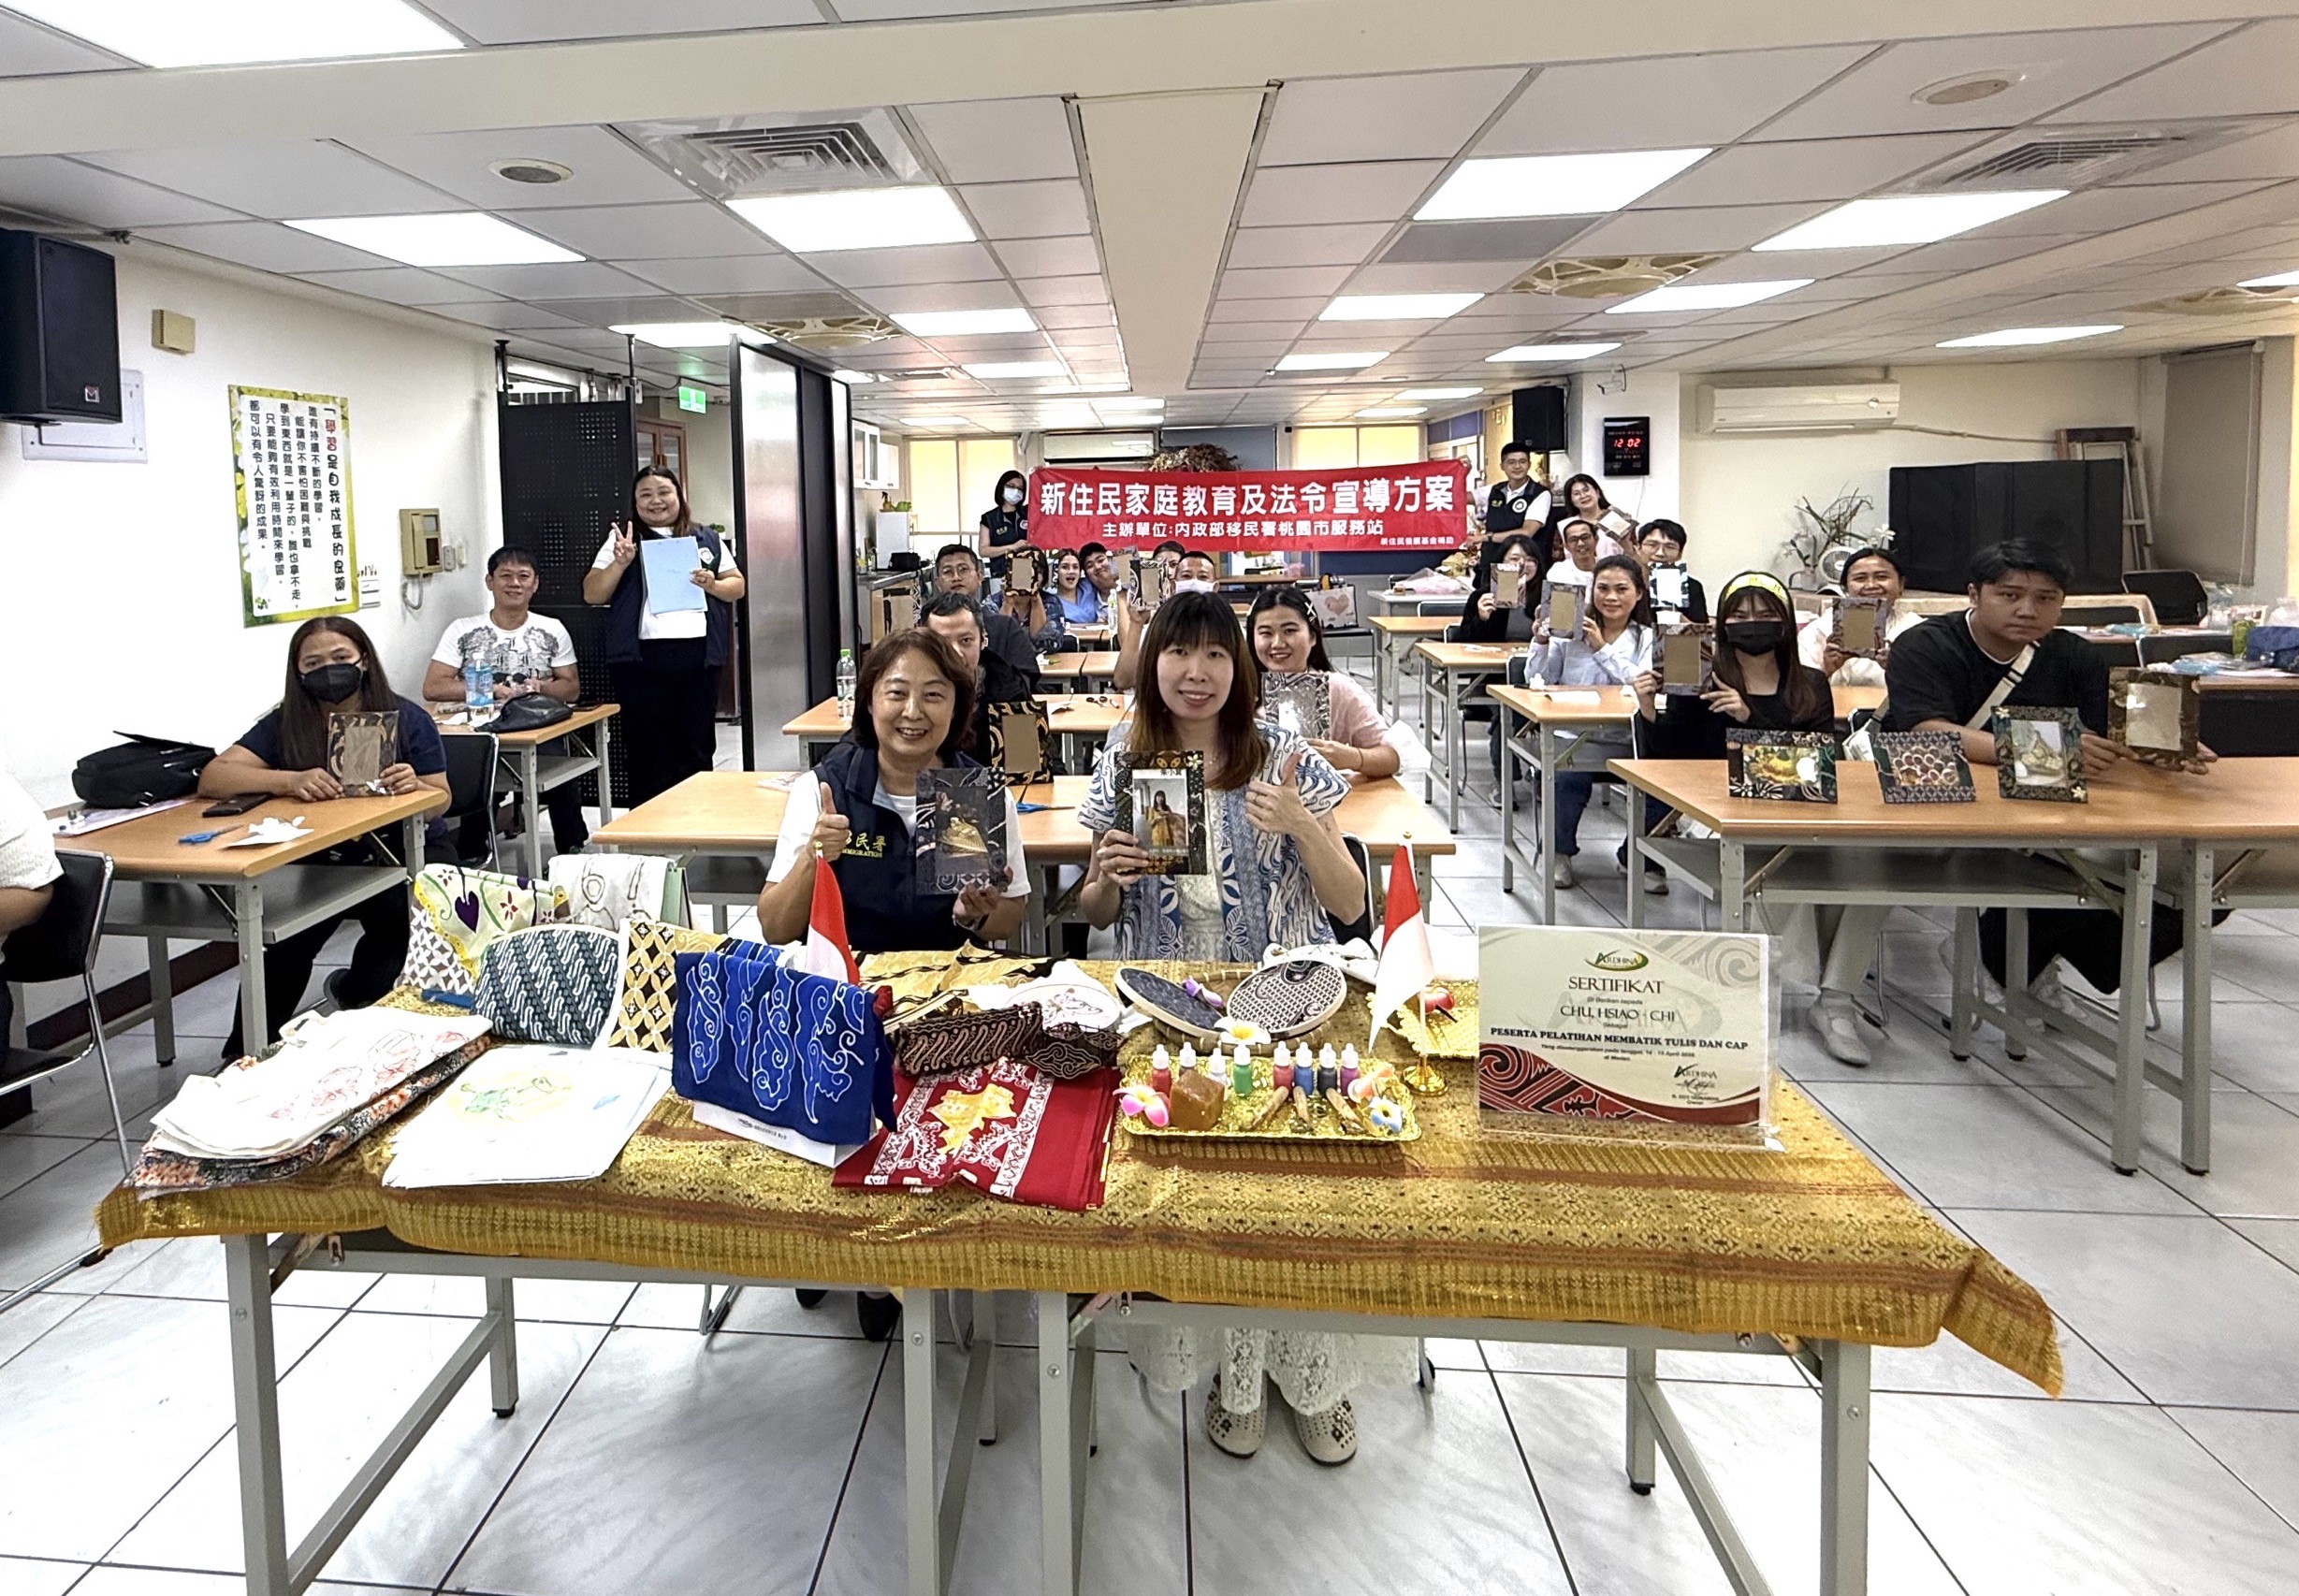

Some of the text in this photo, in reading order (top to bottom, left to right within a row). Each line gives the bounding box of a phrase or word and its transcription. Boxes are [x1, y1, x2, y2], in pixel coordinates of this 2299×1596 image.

[1040, 475, 1453, 516] 新住民家庭教育及法令宣導方案
[1568, 977, 1665, 994] SERTIFIKAT
[1598, 1007, 1639, 1020] HSIAO
[1650, 1009, 1675, 1022] CHI
[1491, 1027, 1748, 1051] PESERTA PELATIHAN MEMBATIK TULIS DAN CAP
